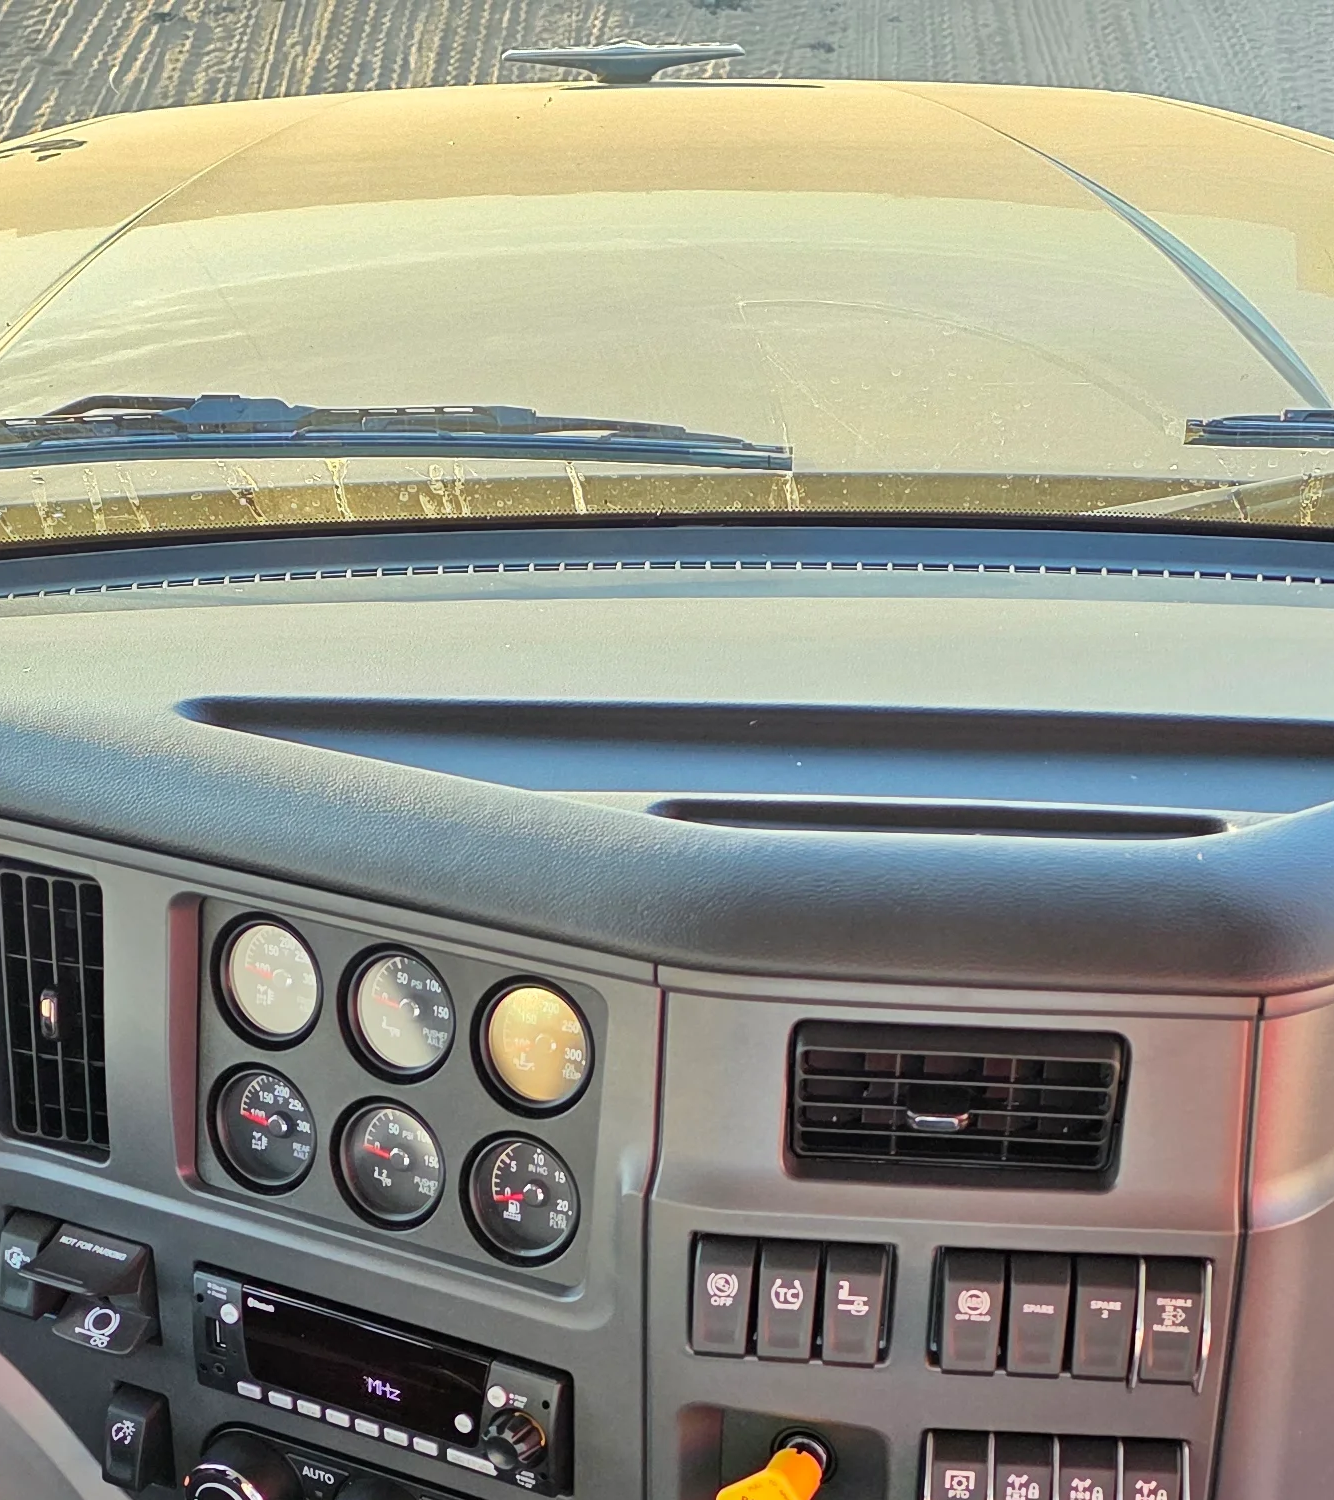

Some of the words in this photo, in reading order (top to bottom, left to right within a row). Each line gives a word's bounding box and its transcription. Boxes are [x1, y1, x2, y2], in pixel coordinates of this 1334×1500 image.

[396, 972, 408, 985] 50
[410, 979, 423, 990] PSI
[433, 1005, 449, 1019] 150
[564, 1047, 582, 1062] 300
[258, 1090, 274, 1105] 150
[274, 1084, 290, 1098] 200
[388, 1122, 400, 1135] 50
[402, 1130, 414, 1140] PSI
[510, 1160, 517, 1172] 5
[533, 1153, 545, 1166] 10
[554, 1170, 566, 1184] 15
[556, 1199, 569, 1212] 20
[549, 1211, 566, 1221] FUEL
[59, 1235, 78, 1247] NOT
[75, 1240, 94, 1252] FOR
[710, 1296, 734, 1307] OFF
[776, 1287, 799, 1302] TC
[1022, 1303, 1054, 1315] SPARE
[1090, 1300, 1122, 1311] SPARE
[366, 1376, 402, 1401] MHz
[302, 1465, 335, 1485] AUTO
[948, 1489, 970, 1499] PTO
